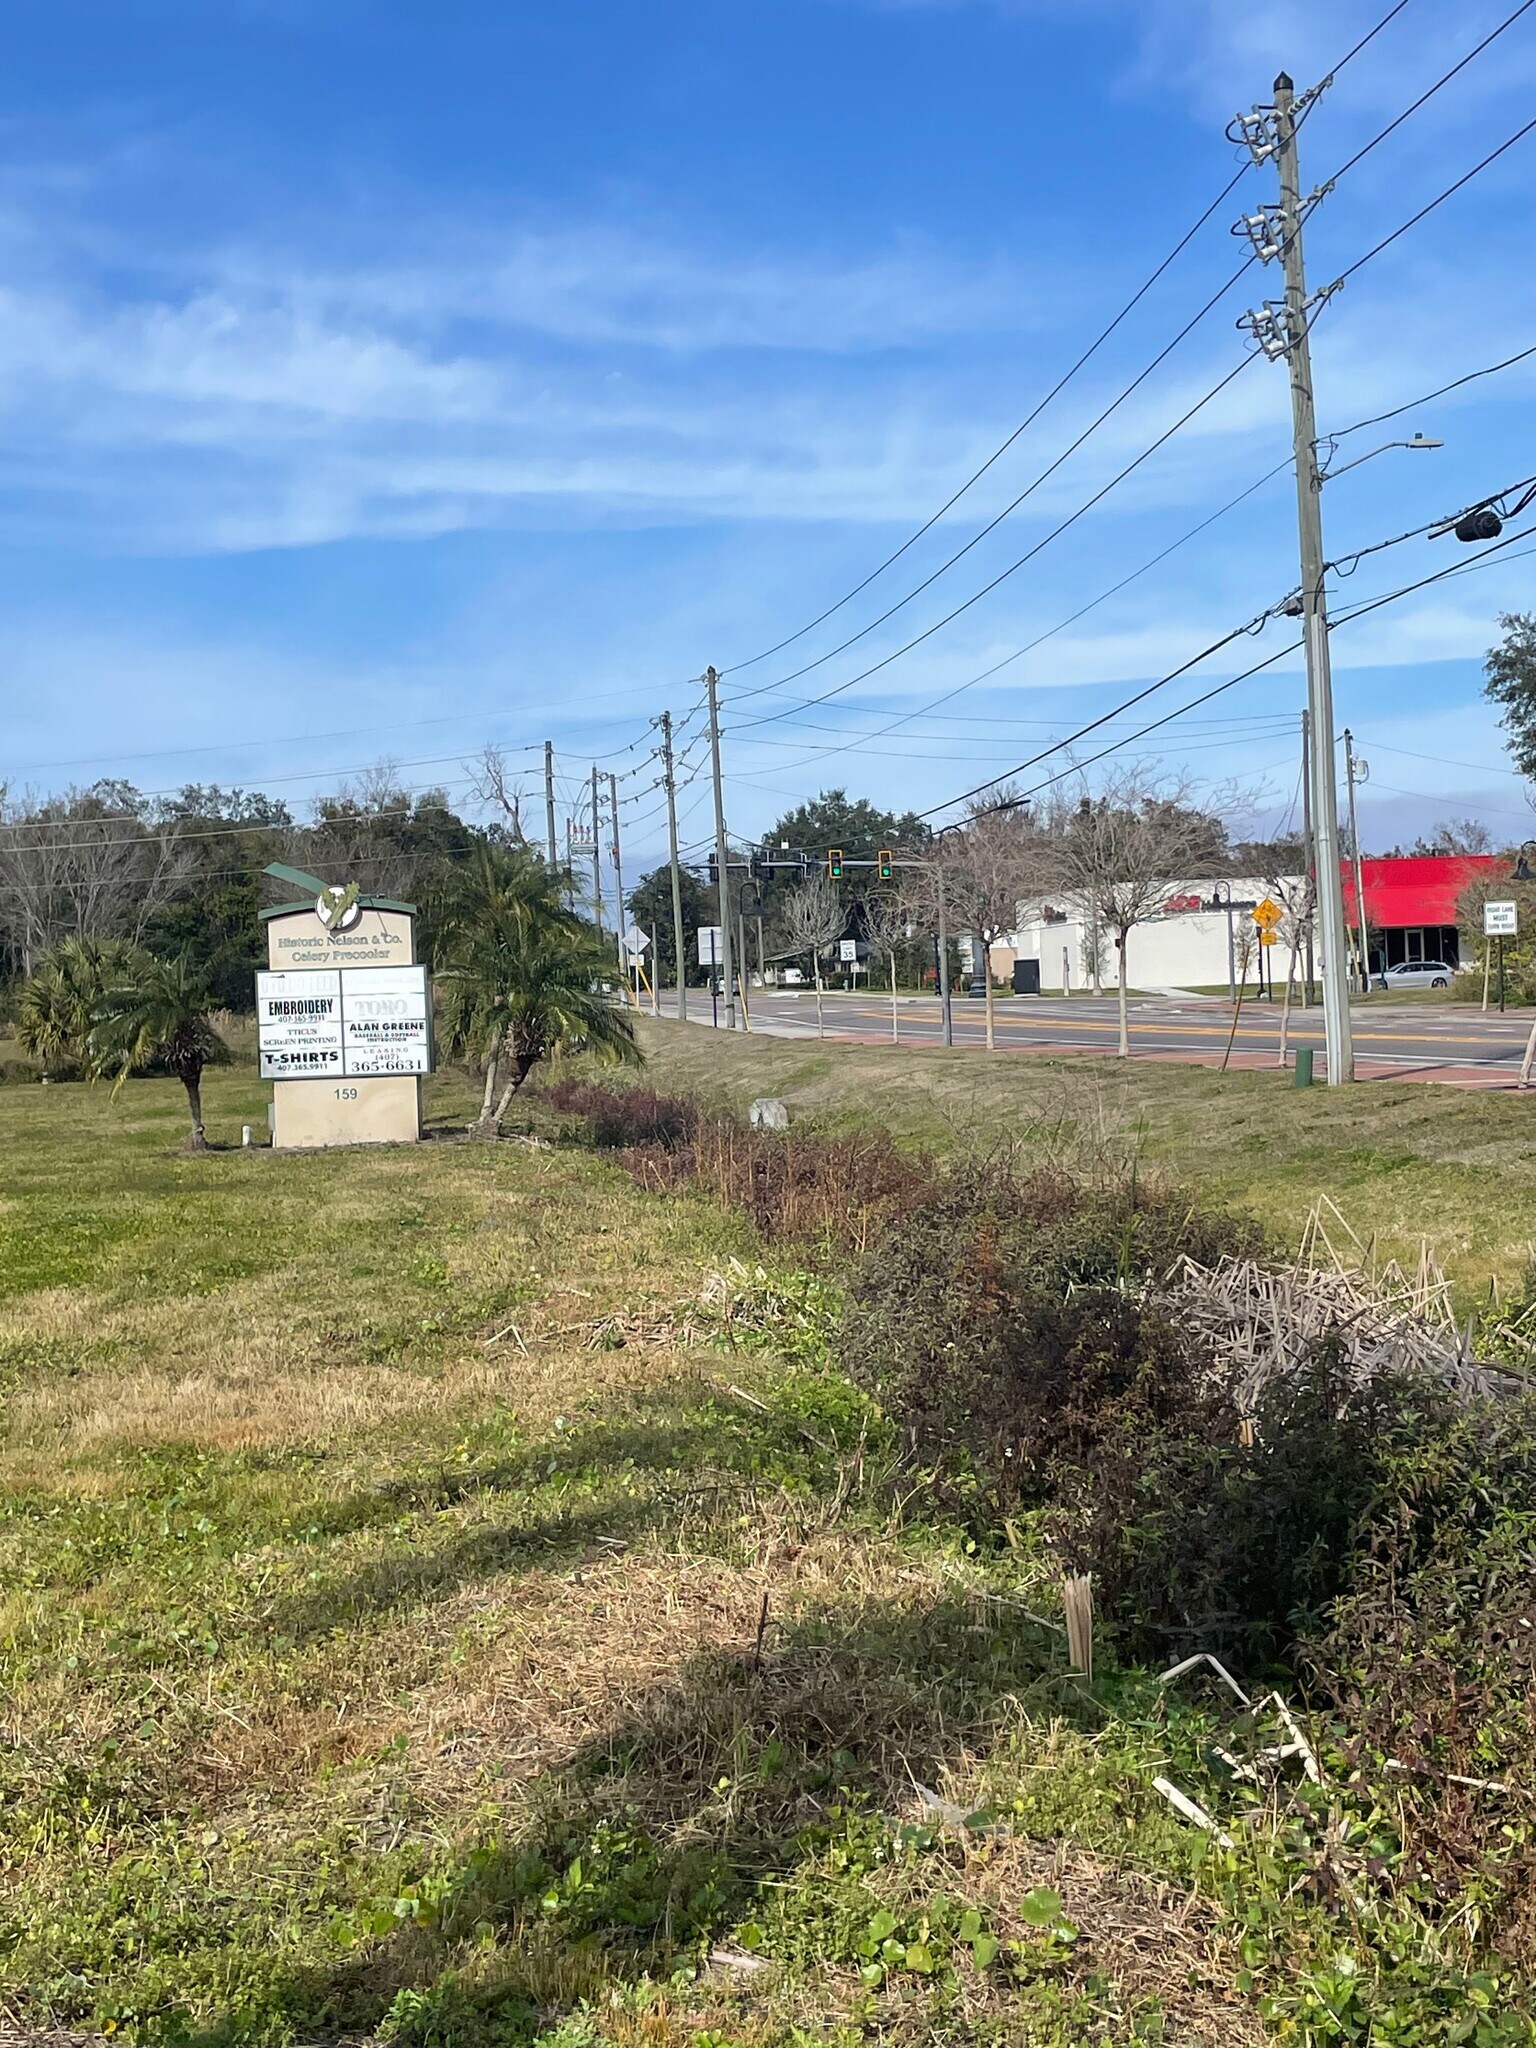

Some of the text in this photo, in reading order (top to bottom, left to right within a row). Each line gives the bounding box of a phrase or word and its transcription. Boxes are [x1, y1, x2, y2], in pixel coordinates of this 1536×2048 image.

[278, 933, 402, 948] Historic Nelson & Co.
[292, 948, 390, 962] Celery Precooler
[268, 998, 333, 1016] EMBROIDERY
[355, 999, 408, 1016] TORO
[350, 1022, 424, 1031] ALAN GREENE
[265, 1052, 338, 1064] T-SHIRTS
[351, 1060, 421, 1072] 365-6631
[334, 1088, 357, 1100] 159
